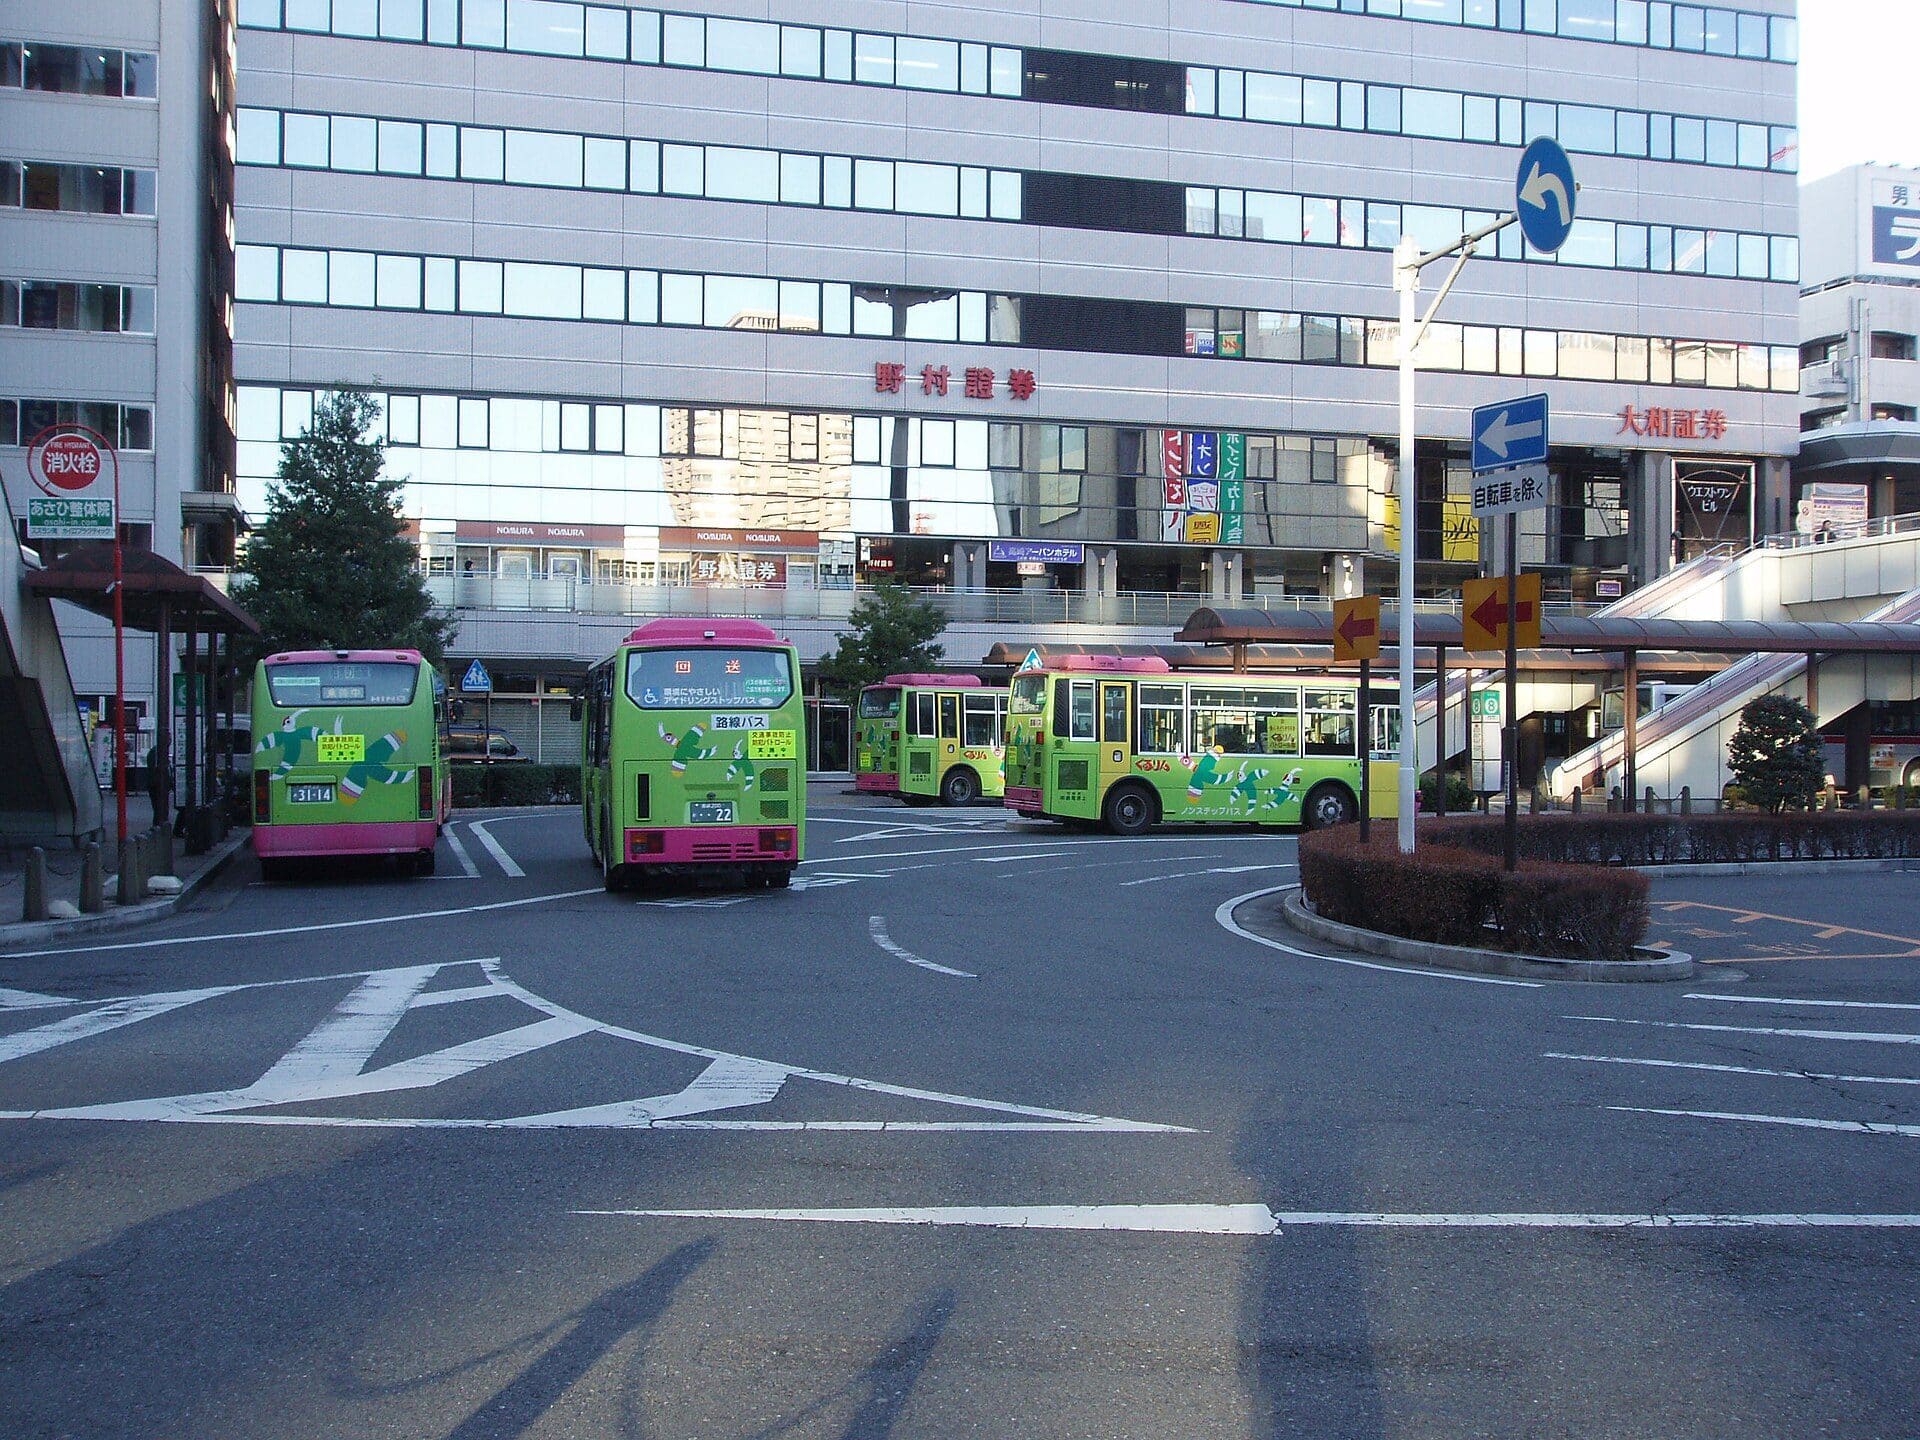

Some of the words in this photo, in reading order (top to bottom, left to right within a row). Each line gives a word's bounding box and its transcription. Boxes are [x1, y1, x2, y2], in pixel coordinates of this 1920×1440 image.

[875, 361, 1036, 401] 野村證券
[1616, 403, 1727, 439] 大和証券
[46, 451, 97, 474] 消火栓
[1474, 477, 1544, 509] 自転車を除く
[1688, 486, 1733, 499] ウエストワン
[30, 501, 111, 517] あさひ整体院
[1702, 500, 1718, 512] ビル
[496, 526, 534, 535] NOMURA
[547, 528, 584, 537] NOMURA
[697, 532, 732, 541] NOMURA
[745, 534, 781, 543] NOMURA
[698, 559, 778, 580] 野村證券
[663, 687, 721, 696] 環境にやさしい
[1486, 699, 1496, 713] 8
[715, 715, 765, 729] 路線バス
[1135, 758, 1171, 773] ぐるりん
[1180, 806, 1242, 817] ノンステップバス
